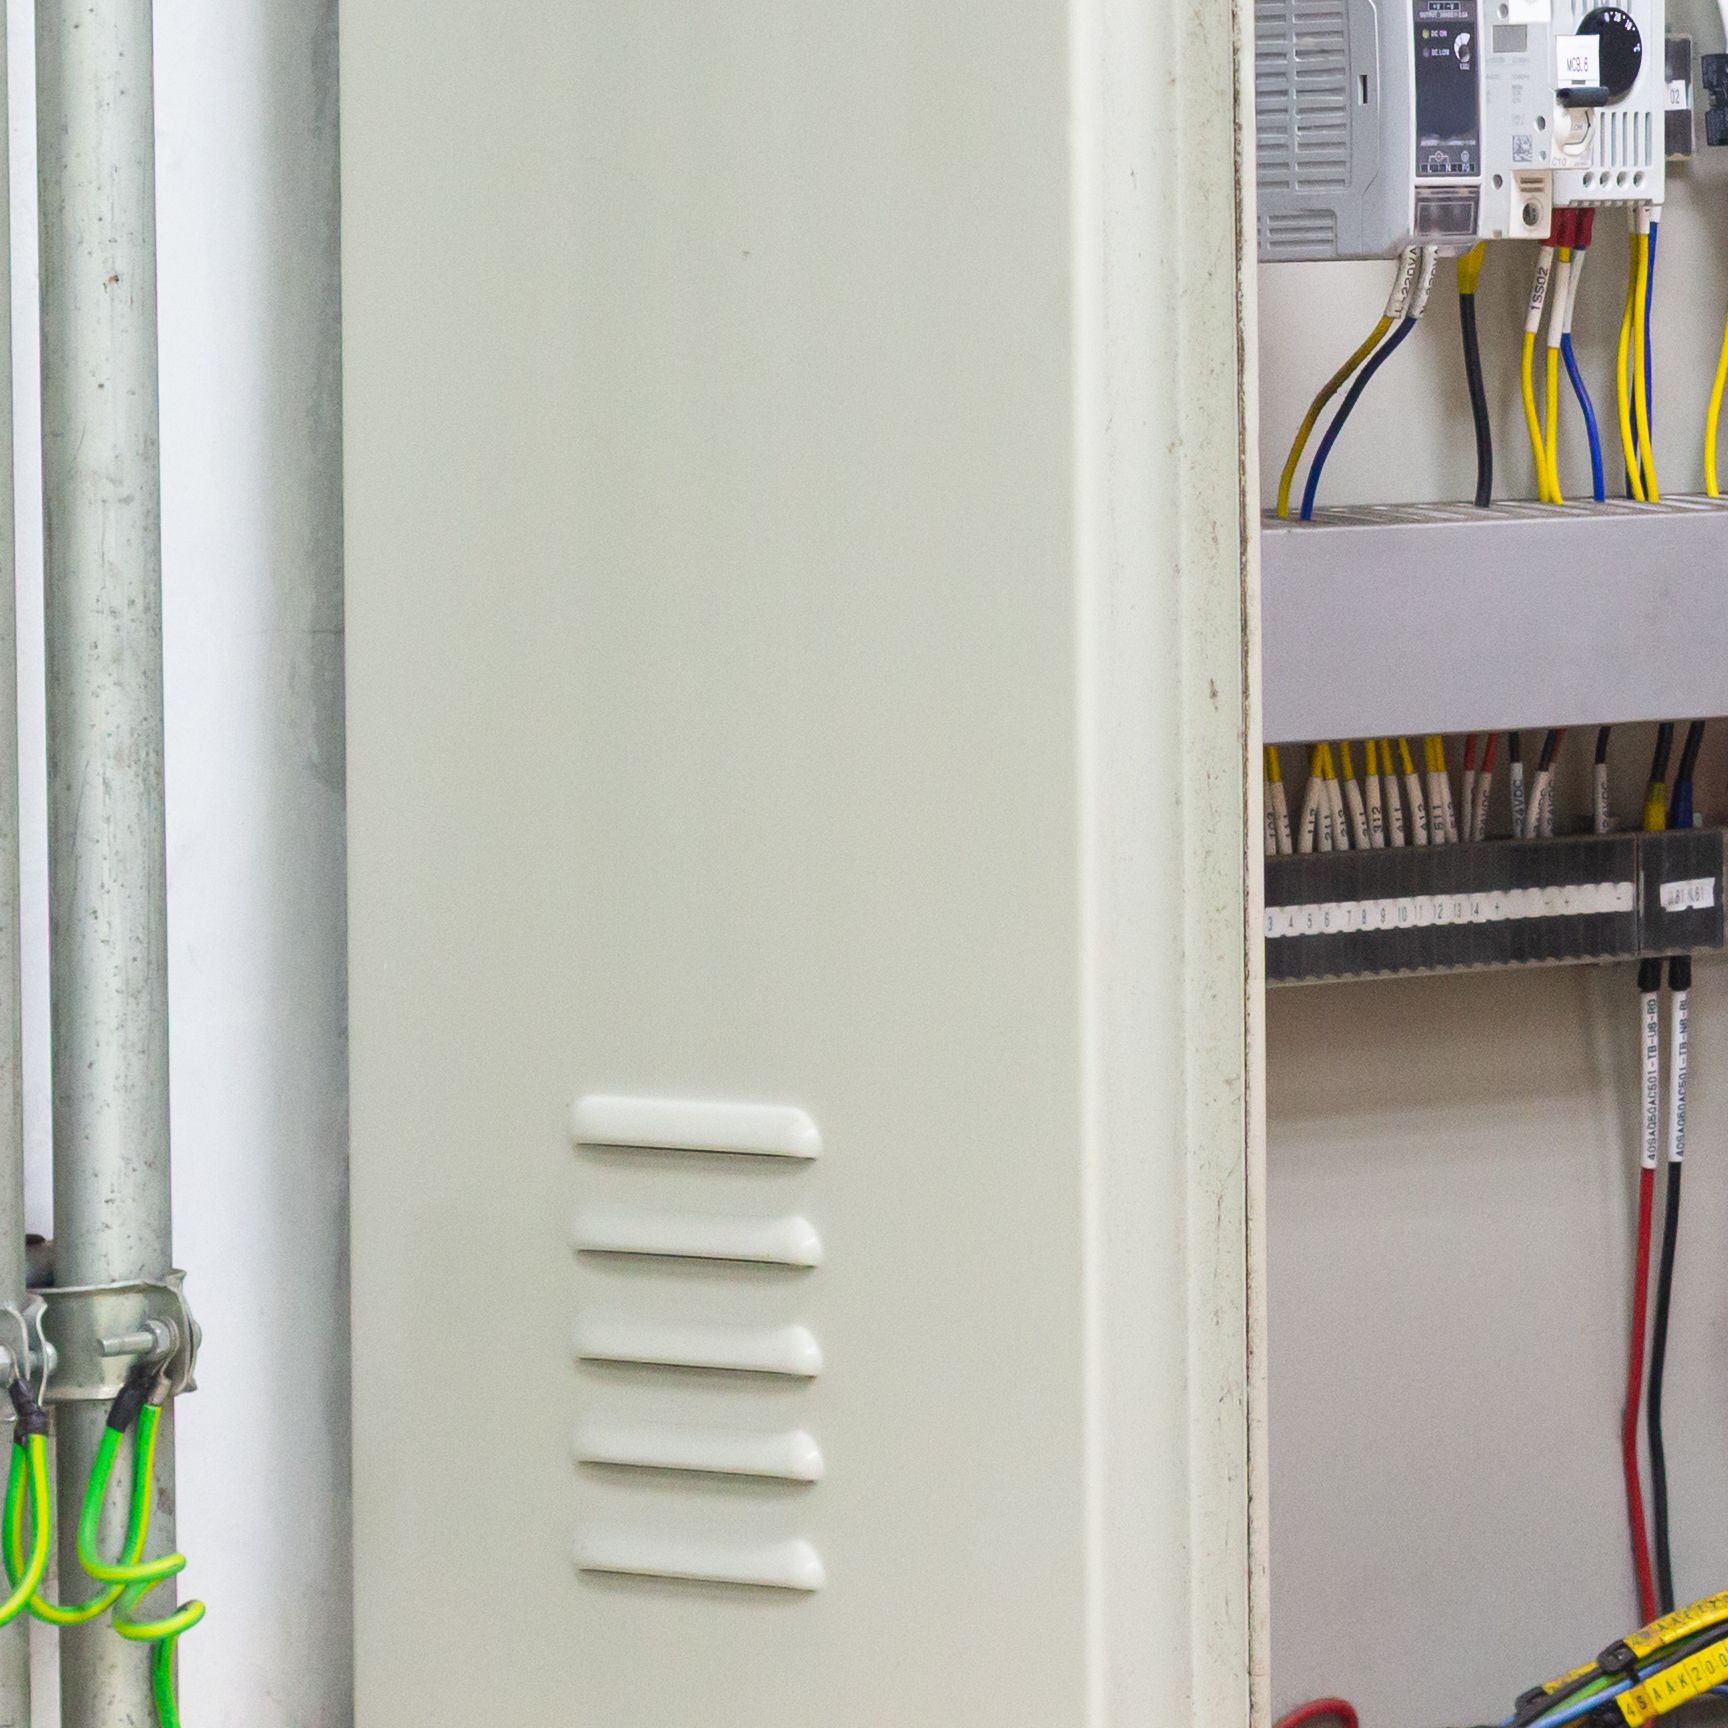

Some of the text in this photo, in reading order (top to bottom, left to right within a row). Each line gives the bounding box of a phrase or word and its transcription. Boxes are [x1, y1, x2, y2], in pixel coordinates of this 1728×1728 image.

[1267, 916, 1273, 932] 3
[1288, 915, 1293, 928] 4
[1307, 913, 1313, 928] 5
[1324, 912, 1330, 928] 6
[1346, 910, 1351, 926] 7
[1362, 909, 1367, 924] 8
[1397, 906, 1408, 922] 10
[1414, 905, 1423, 921] 11
[1433, 903, 1443, 919] 12
[1470, 902, 1479, 917] 14
